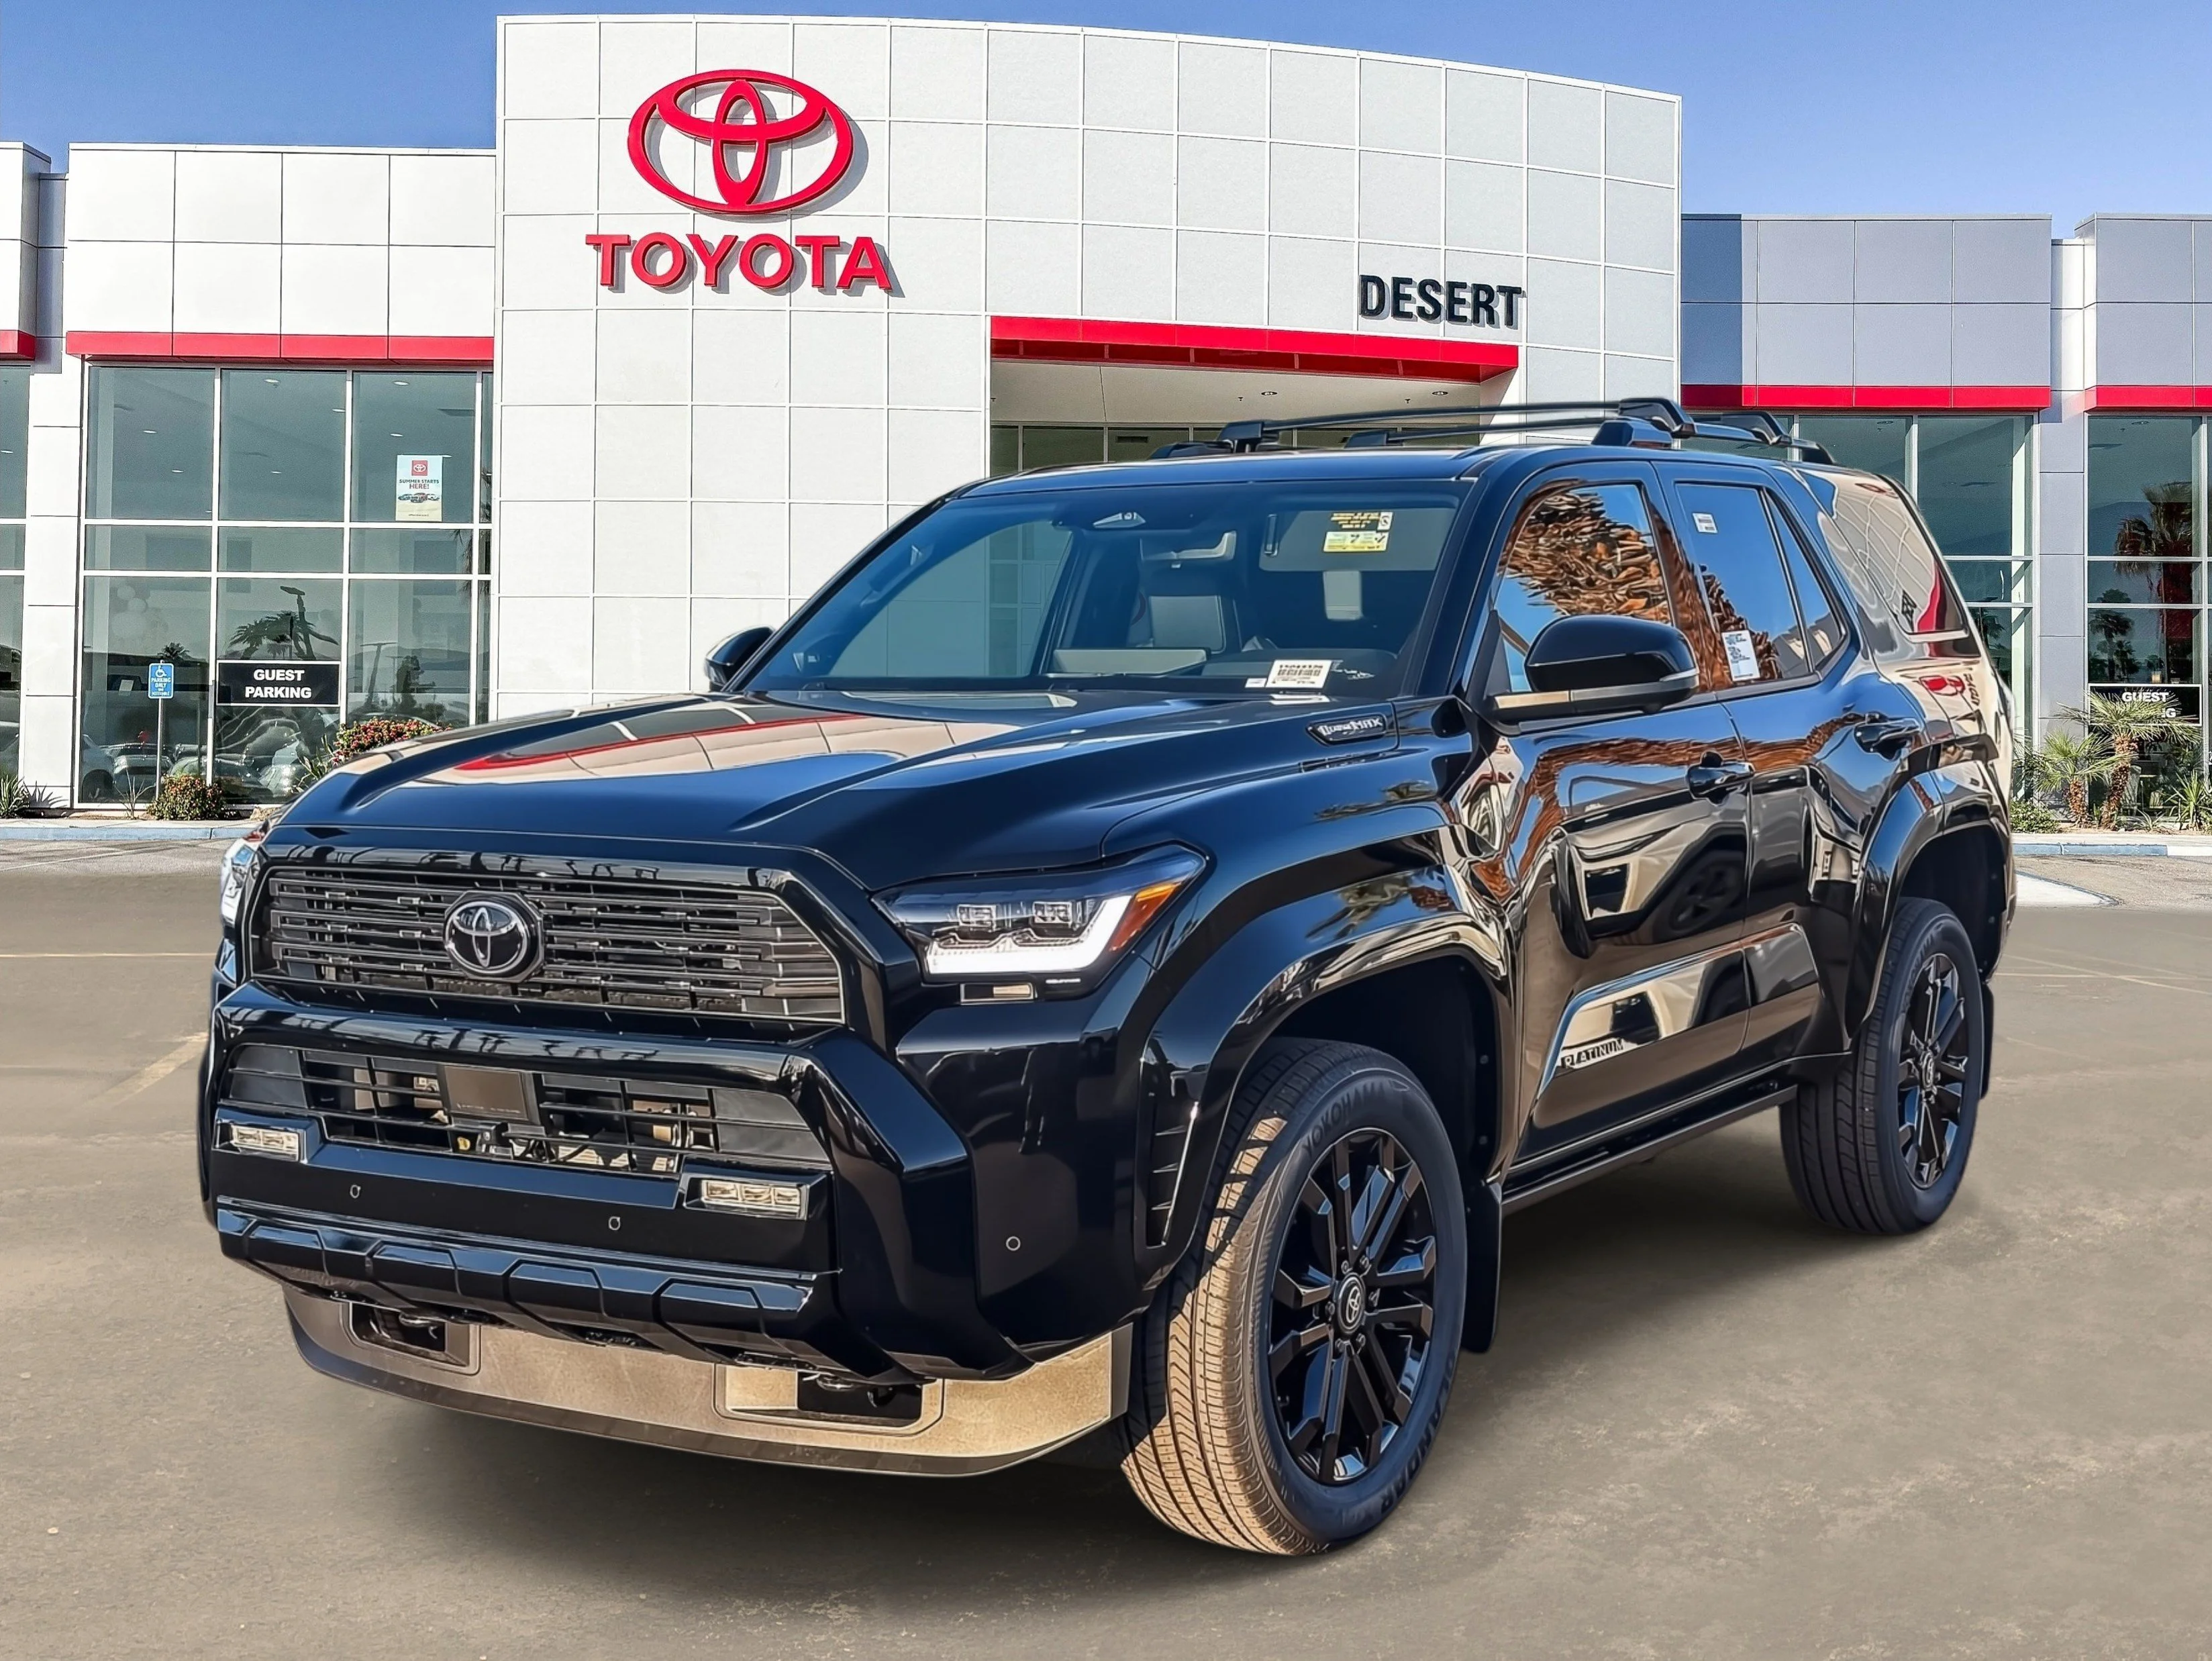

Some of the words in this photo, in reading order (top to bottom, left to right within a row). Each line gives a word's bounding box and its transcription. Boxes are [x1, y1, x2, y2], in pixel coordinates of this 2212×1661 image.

[585, 232, 893, 291] TOYOTA
[1359, 274, 1523, 327] DESERT
[253, 668, 305, 681] GUEST
[244, 686, 312, 699] PARKING
[2121, 691, 2170, 703] GUEST
